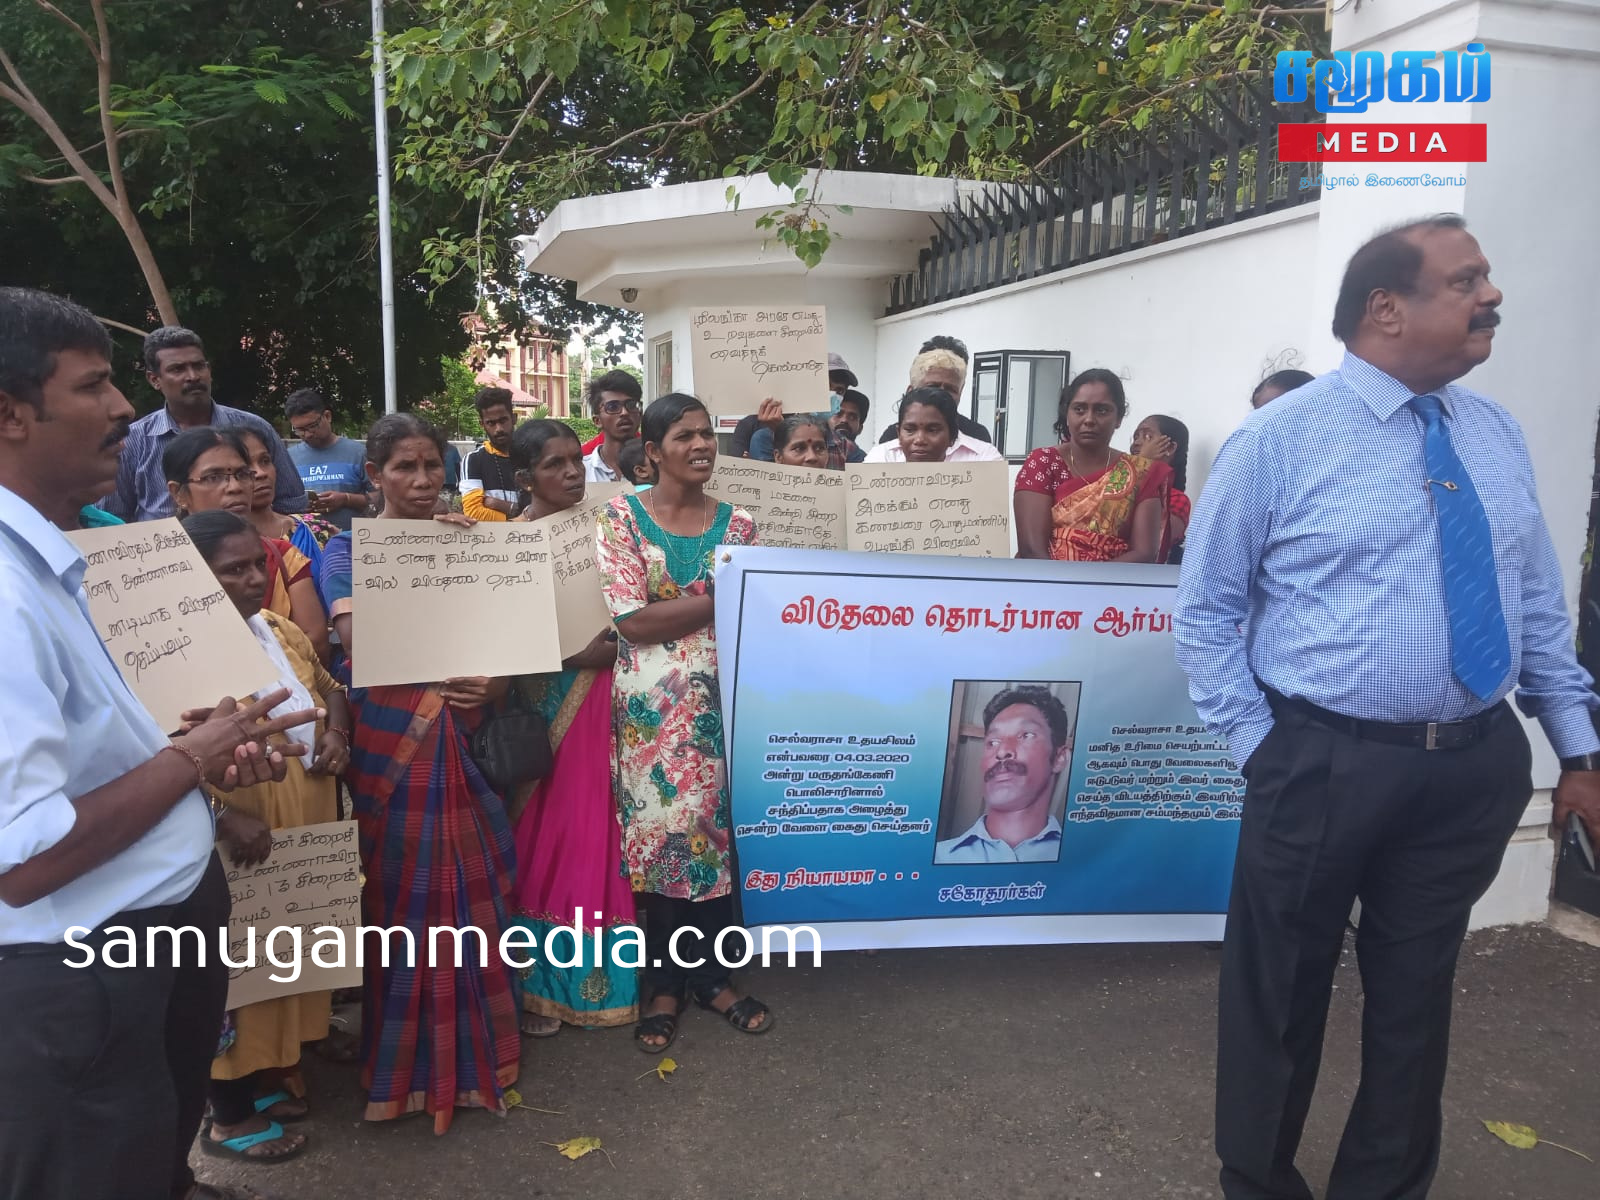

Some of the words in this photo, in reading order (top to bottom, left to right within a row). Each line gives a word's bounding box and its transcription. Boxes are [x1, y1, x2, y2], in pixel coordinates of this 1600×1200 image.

[309, 465, 328, 476] EA7
[713, 464, 812, 488] ண்ணாவிரதம்
[850, 471, 974, 491] உண்ணாவிரதம்
[928, 498, 972, 514] எனது
[85, 537, 153, 566] ணாவிரதம்
[397, 553, 437, 570] எனது
[781, 595, 915, 634] விடுதலை
[925, 602, 1083, 636] தொடர்பான
[1094, 606, 1173, 637] ஆர்ப்
[1111, 724, 1173, 736] செல்வராசா
[768, 731, 843, 746] செல்வராசா
[1088, 742, 1121, 754] மனித
[1123, 741, 1162, 753] உரிமை
[766, 750, 830, 763] என்பவரை
[834, 753, 911, 763] 04.03.2020
[1086, 757, 1128, 771] ஆகவும்
[1131, 759, 1162, 770] பொது
[763, 768, 804, 783] அன்று
[808, 768, 895, 782] மருதங்கேணி
[1138, 772, 1175, 787] மற்றும்
[1178, 773, 1209, 785] இவர்
[785, 785, 884, 798] பொலிசாரினால்
[1077, 790, 1111, 804] செய்த
[767, 803, 845, 818] சந்திப்பதாக
[848, 803, 908, 817] அழைத்து
[1214, 807, 1242, 819] இல்
[736, 821, 778, 836] சென்ற
[781, 823, 828, 833] வேளை
[831, 823, 868, 834] கைது
[871, 819, 931, 833] செய்தனர்
[747, 870, 780, 891] இது
[782, 868, 876, 891] நியாயமா
[937, 882, 1046, 906] சகோதரர்கள்
